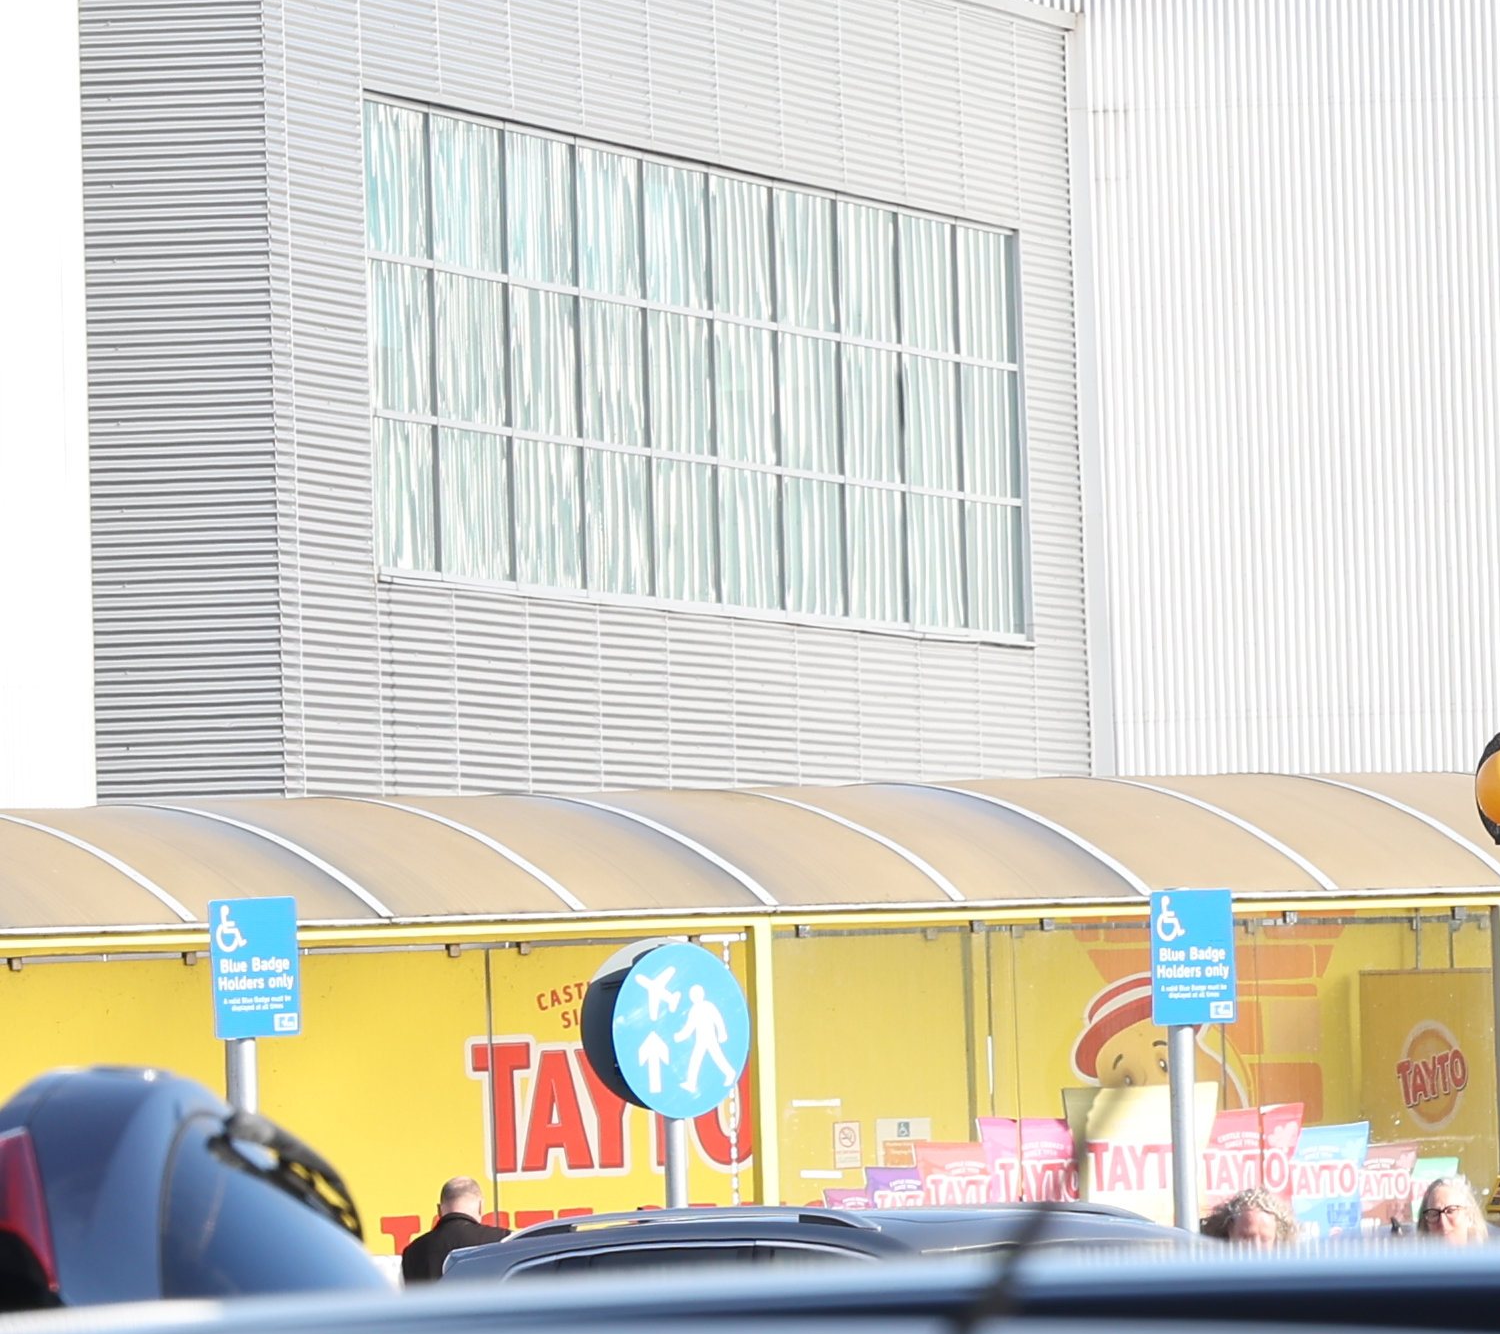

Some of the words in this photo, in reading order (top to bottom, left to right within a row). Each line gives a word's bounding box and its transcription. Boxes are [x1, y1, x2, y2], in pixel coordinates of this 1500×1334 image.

[220, 958, 248, 974] Blue
[252, 956, 290, 972] Badge
[1159, 947, 1185, 962] Blue
[1189, 946, 1226, 962] Badge
[218, 976, 265, 991] Holders
[268, 973, 294, 990] only
[1156, 964, 1202, 979] Holders
[1205, 963, 1230, 979] only
[536, 982, 588, 1011] CAST
[1396, 1048, 1467, 1107] TAYTO
[472, 1041, 752, 1173] TAYO
[1087, 1142, 1174, 1192] TAYT
[1204, 1149, 1288, 1190] TAYTO
[930, 1178, 985, 1207] TAYT
